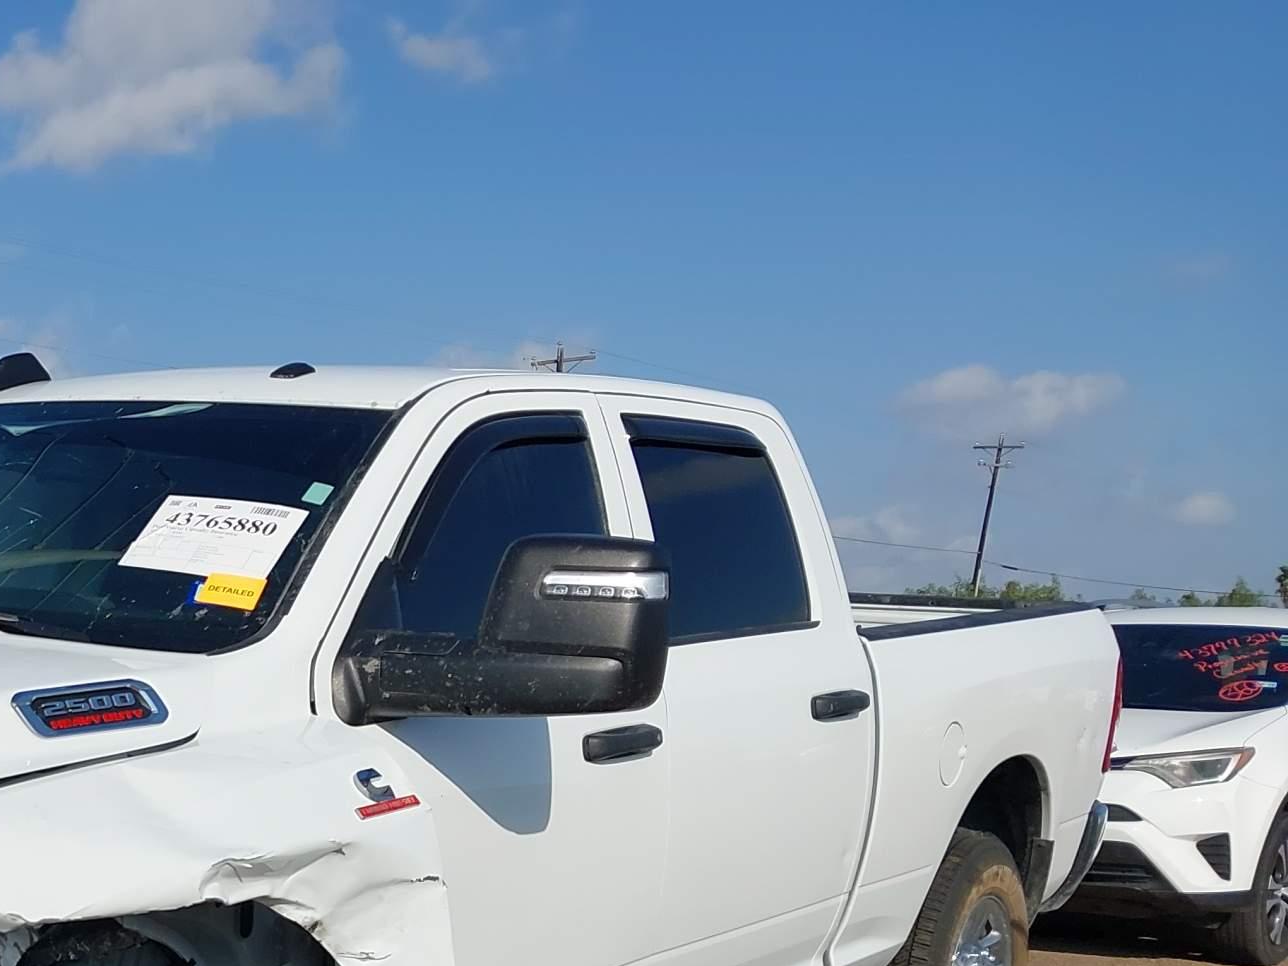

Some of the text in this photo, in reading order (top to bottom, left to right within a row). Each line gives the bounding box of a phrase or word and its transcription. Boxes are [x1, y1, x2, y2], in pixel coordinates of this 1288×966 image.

[165, 511, 278, 536] 43765880
[208, 583, 255, 598] DETAILED
[42, 692, 135, 716] 2500
